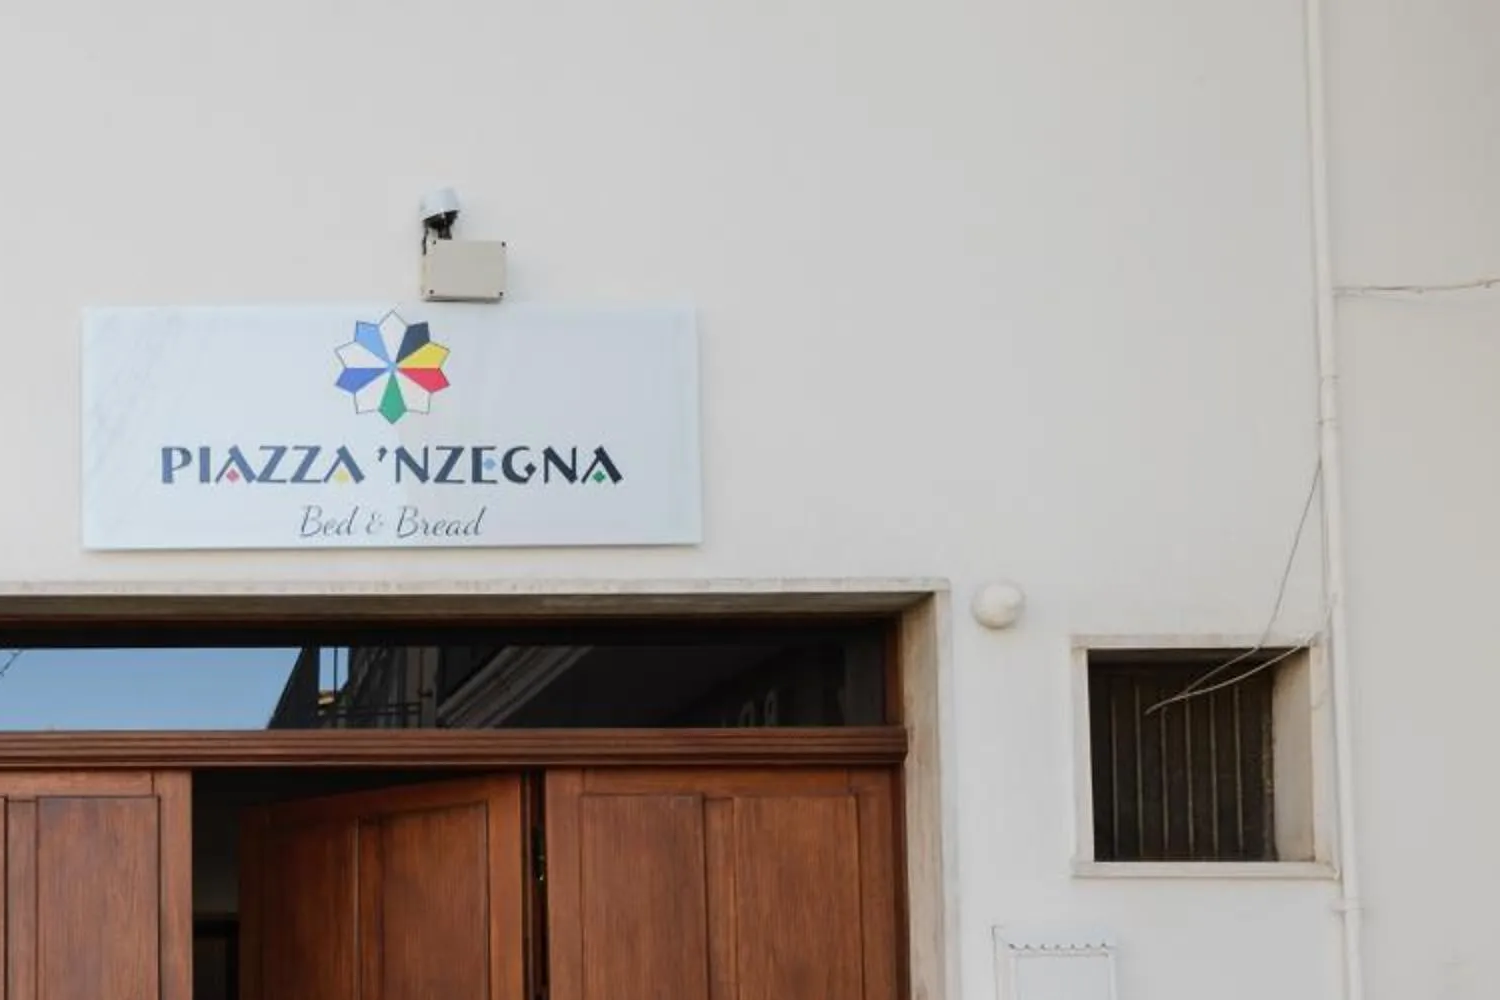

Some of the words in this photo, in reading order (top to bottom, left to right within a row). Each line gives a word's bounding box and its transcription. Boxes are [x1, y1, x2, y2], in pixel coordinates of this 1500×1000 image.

[161, 444, 366, 485] PIAZZA
[299, 504, 361, 538] Bed
[365, 510, 384, 536] &
[396, 504, 488, 539] Bread
